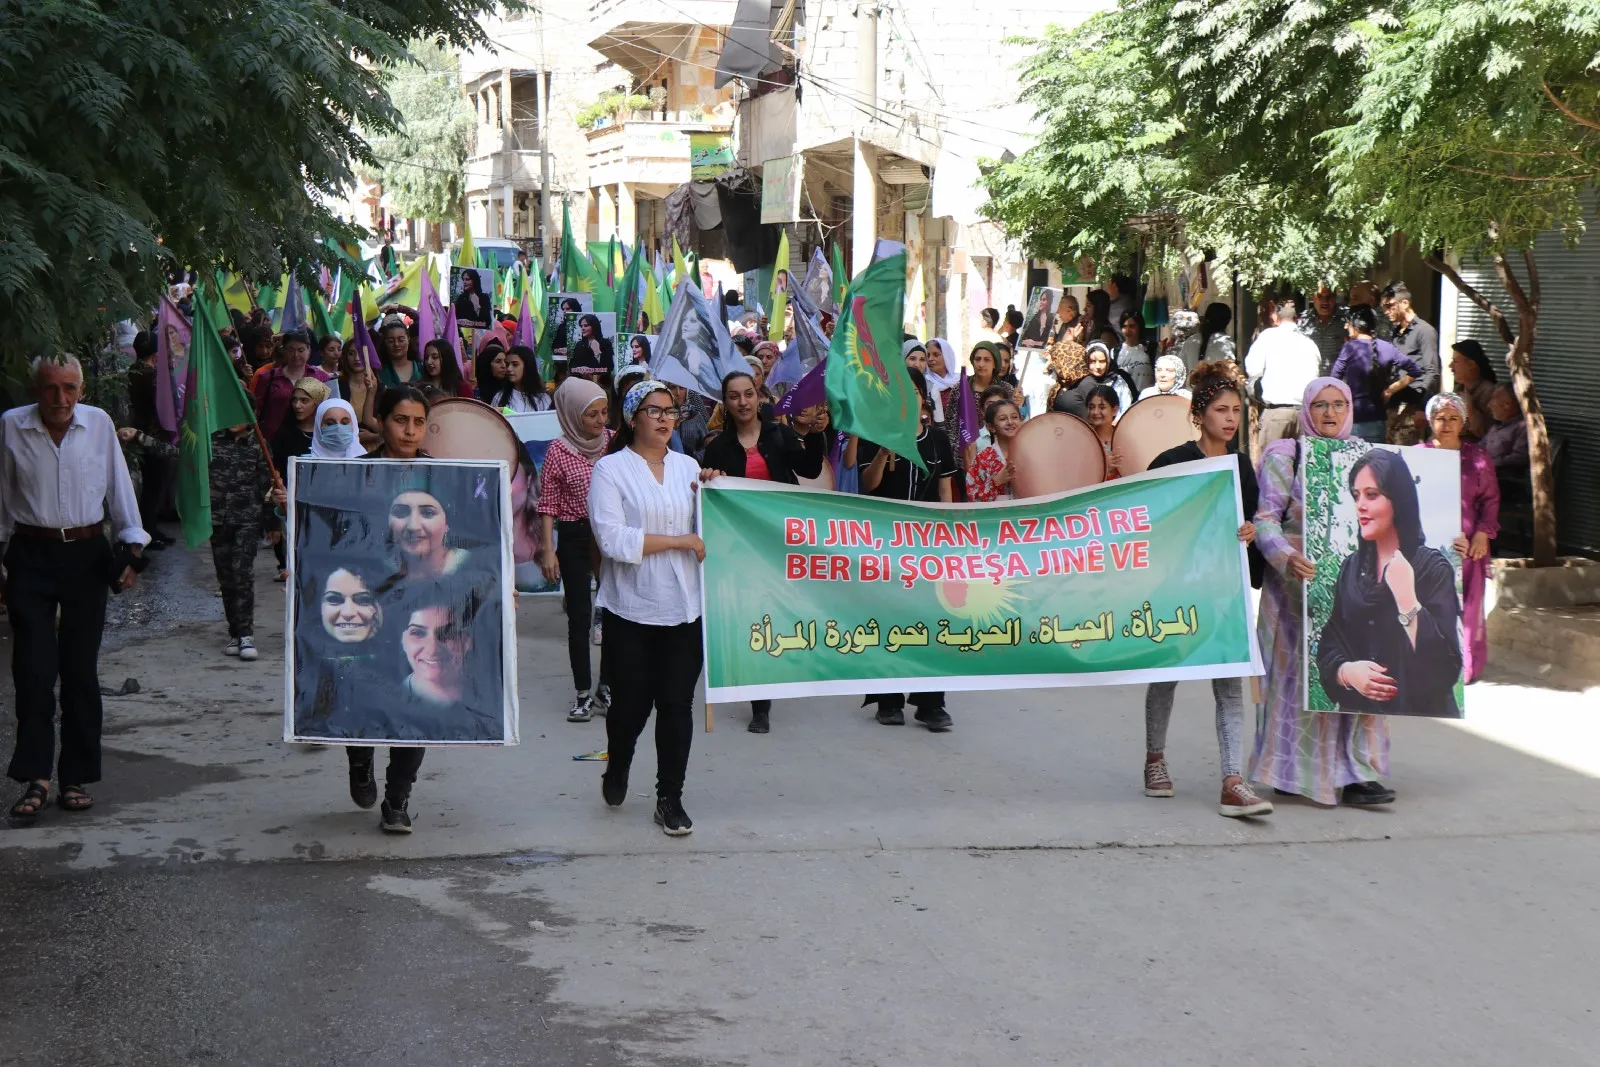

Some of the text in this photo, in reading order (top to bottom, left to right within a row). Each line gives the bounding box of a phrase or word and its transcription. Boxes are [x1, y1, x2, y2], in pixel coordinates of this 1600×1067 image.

[784, 505, 1152, 550] BI JIN, JIYAN, AZADÎ RE
[785, 540, 1150, 589] BER BI ŞOREŞA JINÊ VE
[749, 601, 1199, 658] المرأة، الحياة، الحرية نحو ثورة المرأة
